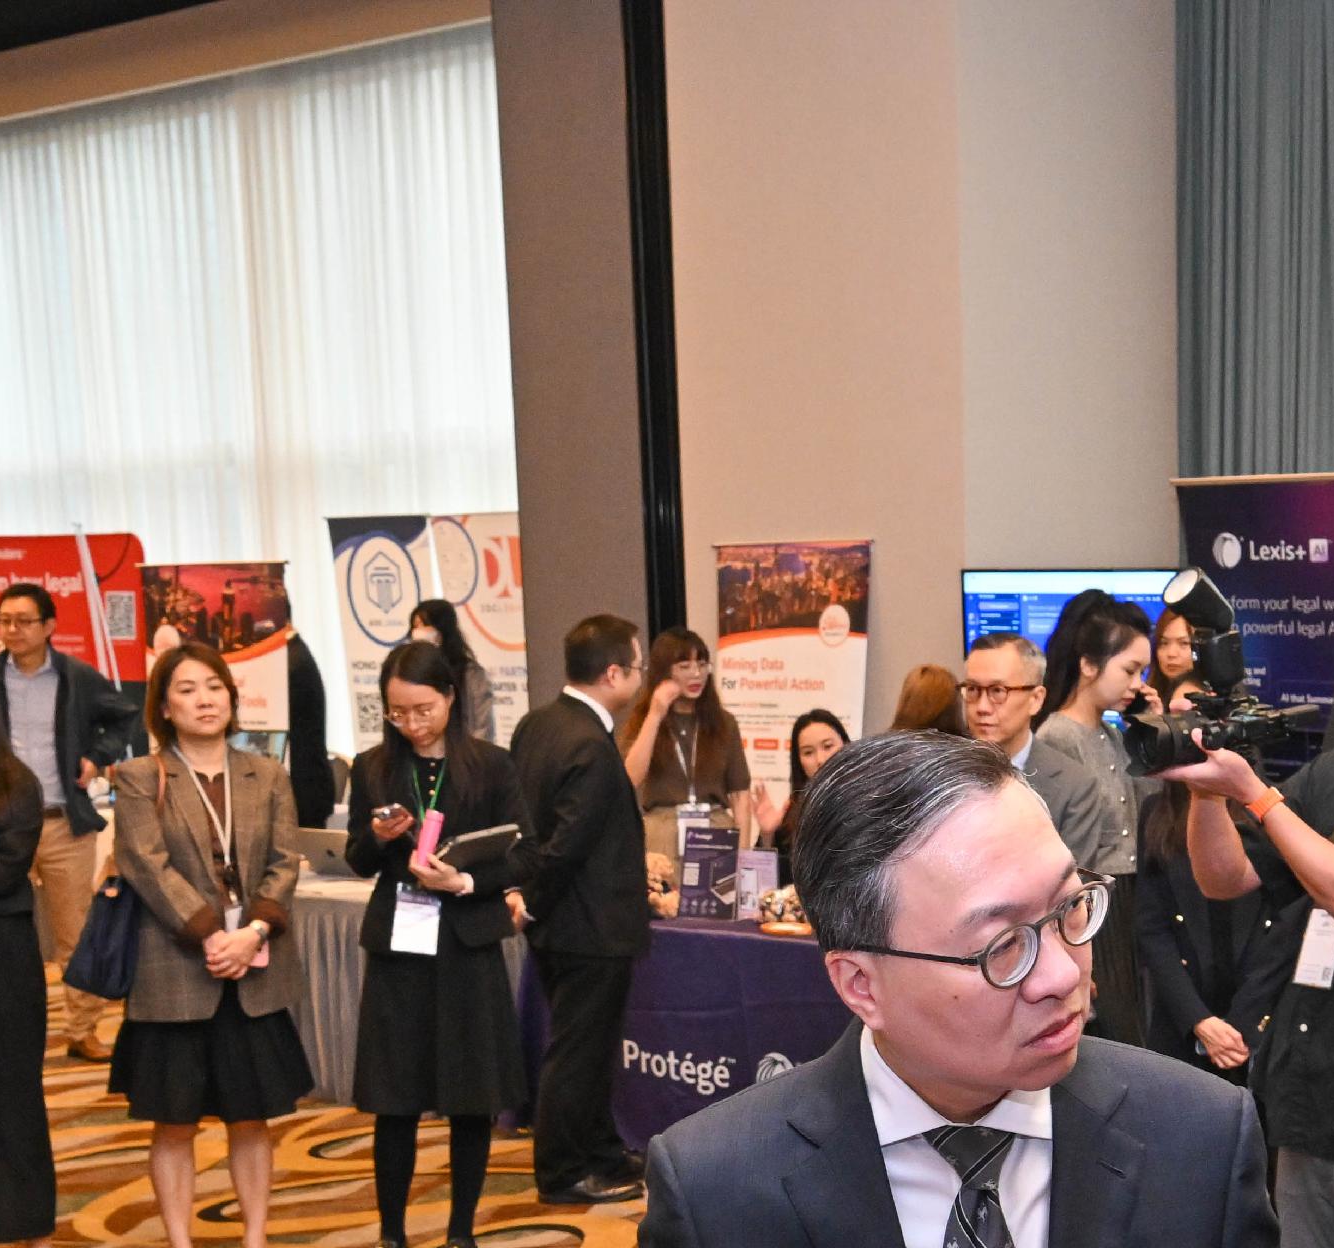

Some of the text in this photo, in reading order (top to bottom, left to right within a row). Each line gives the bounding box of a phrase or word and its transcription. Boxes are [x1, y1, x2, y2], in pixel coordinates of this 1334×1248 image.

[1249, 540, 1307, 561] Lexis+
[45, 572, 84, 597] legal
[1263, 599, 1289, 612] your
[1292, 595, 1320, 613] legal
[1243, 620, 1295, 637] powerful
[1297, 620, 1325, 638] legal
[722, 657, 785, 673] Mining Data
[722, 678, 825, 691] For Powerful Action
[622, 1039, 730, 1095] Protégé
